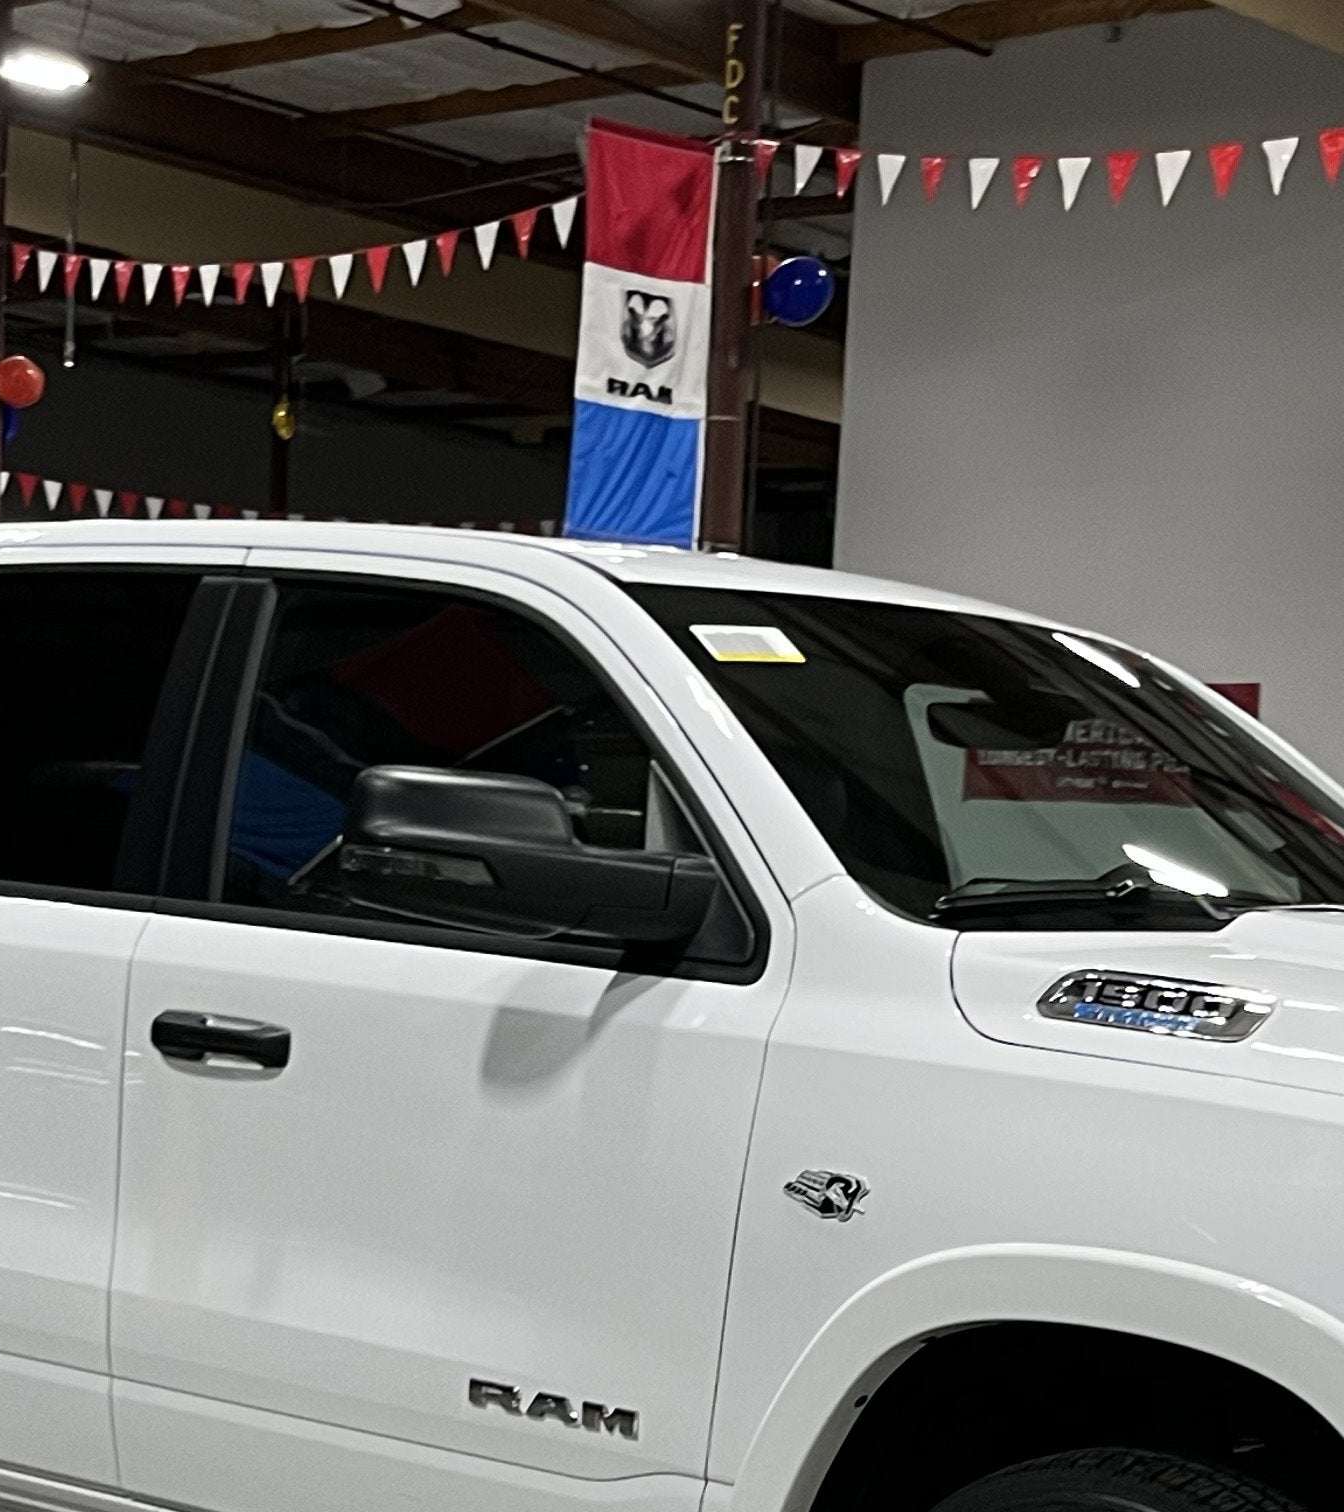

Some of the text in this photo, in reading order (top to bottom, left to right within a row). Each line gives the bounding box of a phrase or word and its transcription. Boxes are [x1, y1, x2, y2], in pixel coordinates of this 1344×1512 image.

[606, 377, 673, 405] RAM
[1081, 979, 1237, 1020] 1500
[469, 1378, 640, 1441] RAM
